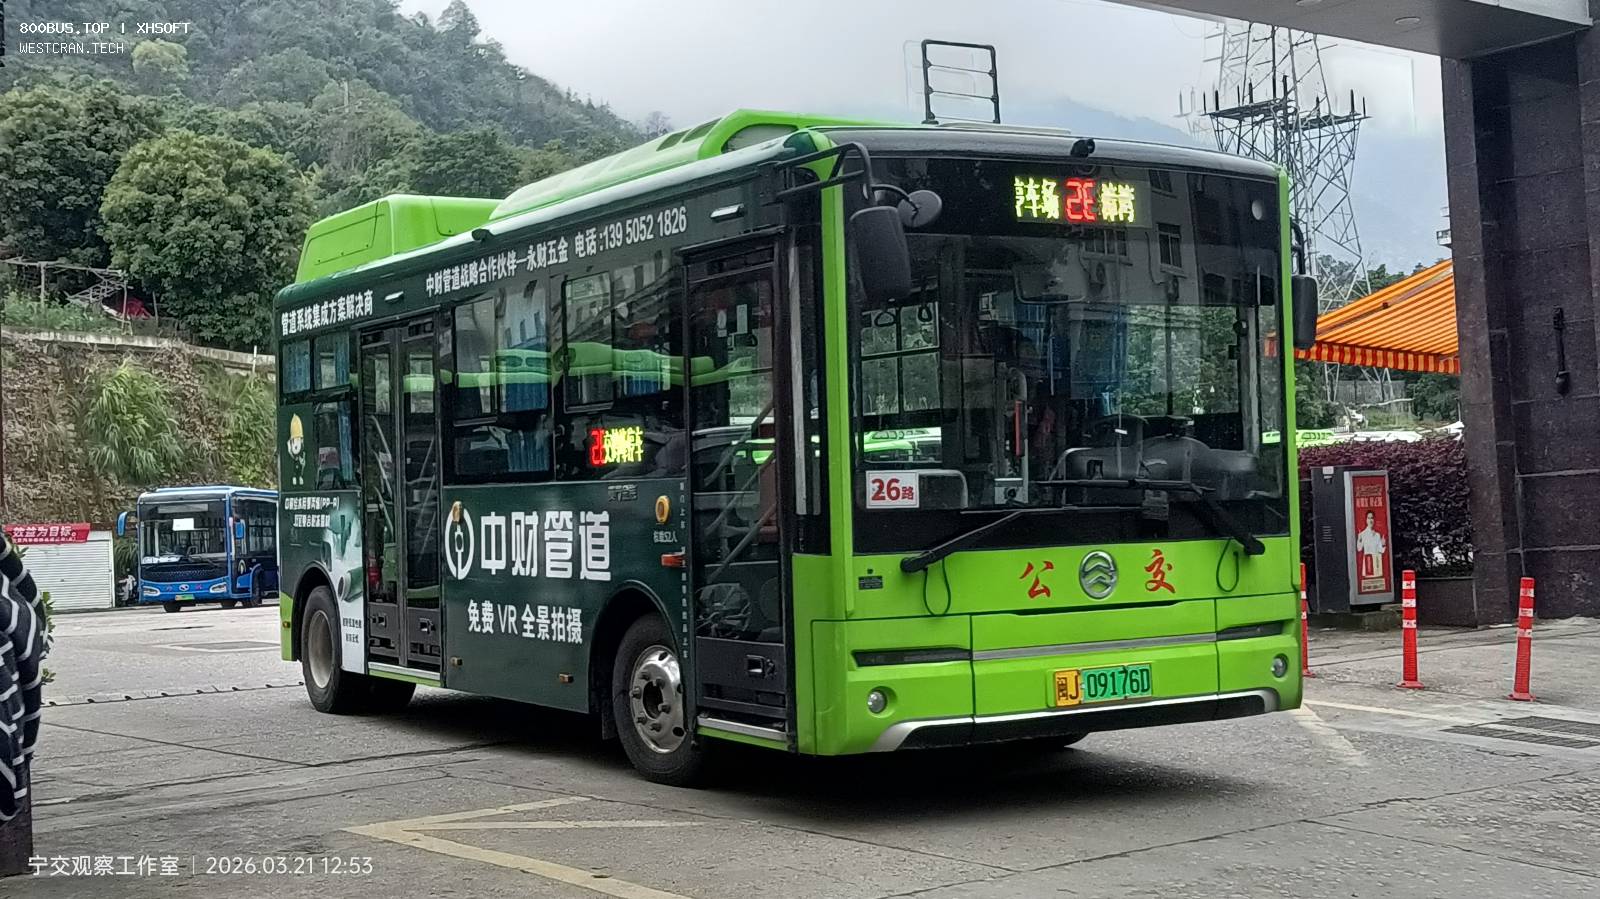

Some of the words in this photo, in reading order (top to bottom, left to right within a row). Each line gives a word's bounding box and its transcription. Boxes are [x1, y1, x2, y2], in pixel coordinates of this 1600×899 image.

[625, 214, 654, 244] 5052
[657, 206, 687, 237] 1826
[281, 289, 373, 336] 管道系统集成方案解决商
[871, 478, 914, 501] 26路
[480, 510, 611, 582] 中财管道
[1019, 560, 1054, 599] 公
[1144, 548, 1176, 594] 交
[467, 599, 495, 634] 免费
[497, 604, 518, 635] VR
[520, 603, 583, 644] 全景拍摄
[1086, 668, 1151, 697] 09176D
